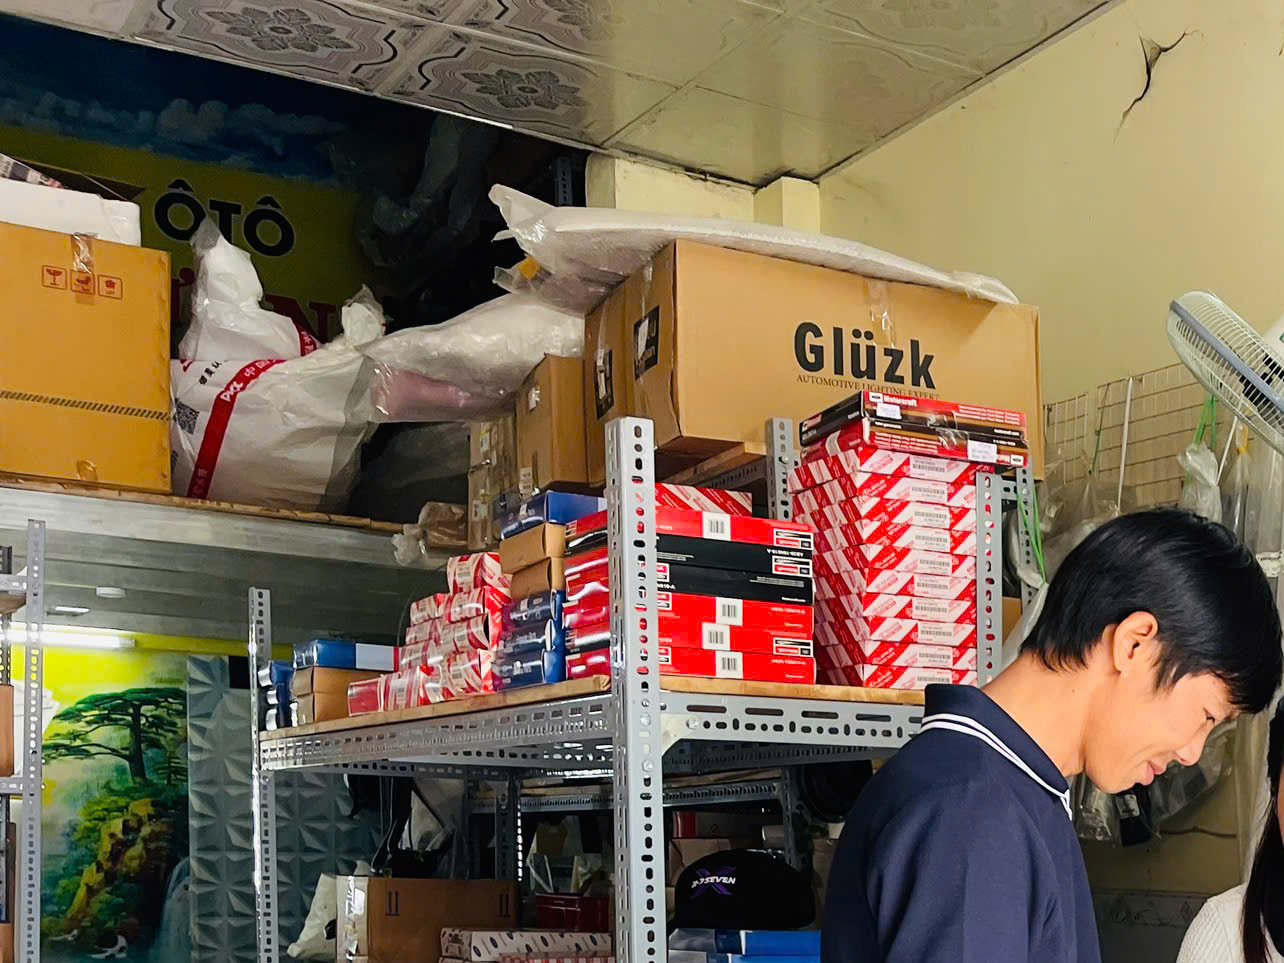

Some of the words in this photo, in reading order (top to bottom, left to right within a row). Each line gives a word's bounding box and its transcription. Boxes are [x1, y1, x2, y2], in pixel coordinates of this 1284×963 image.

[154, 178, 296, 257] ÔTÔ
[794, 322, 936, 389] Glüzk
[796, 374, 859, 391] AUTOMOTIVE
[862, 382, 906, 396] LIGHTING
